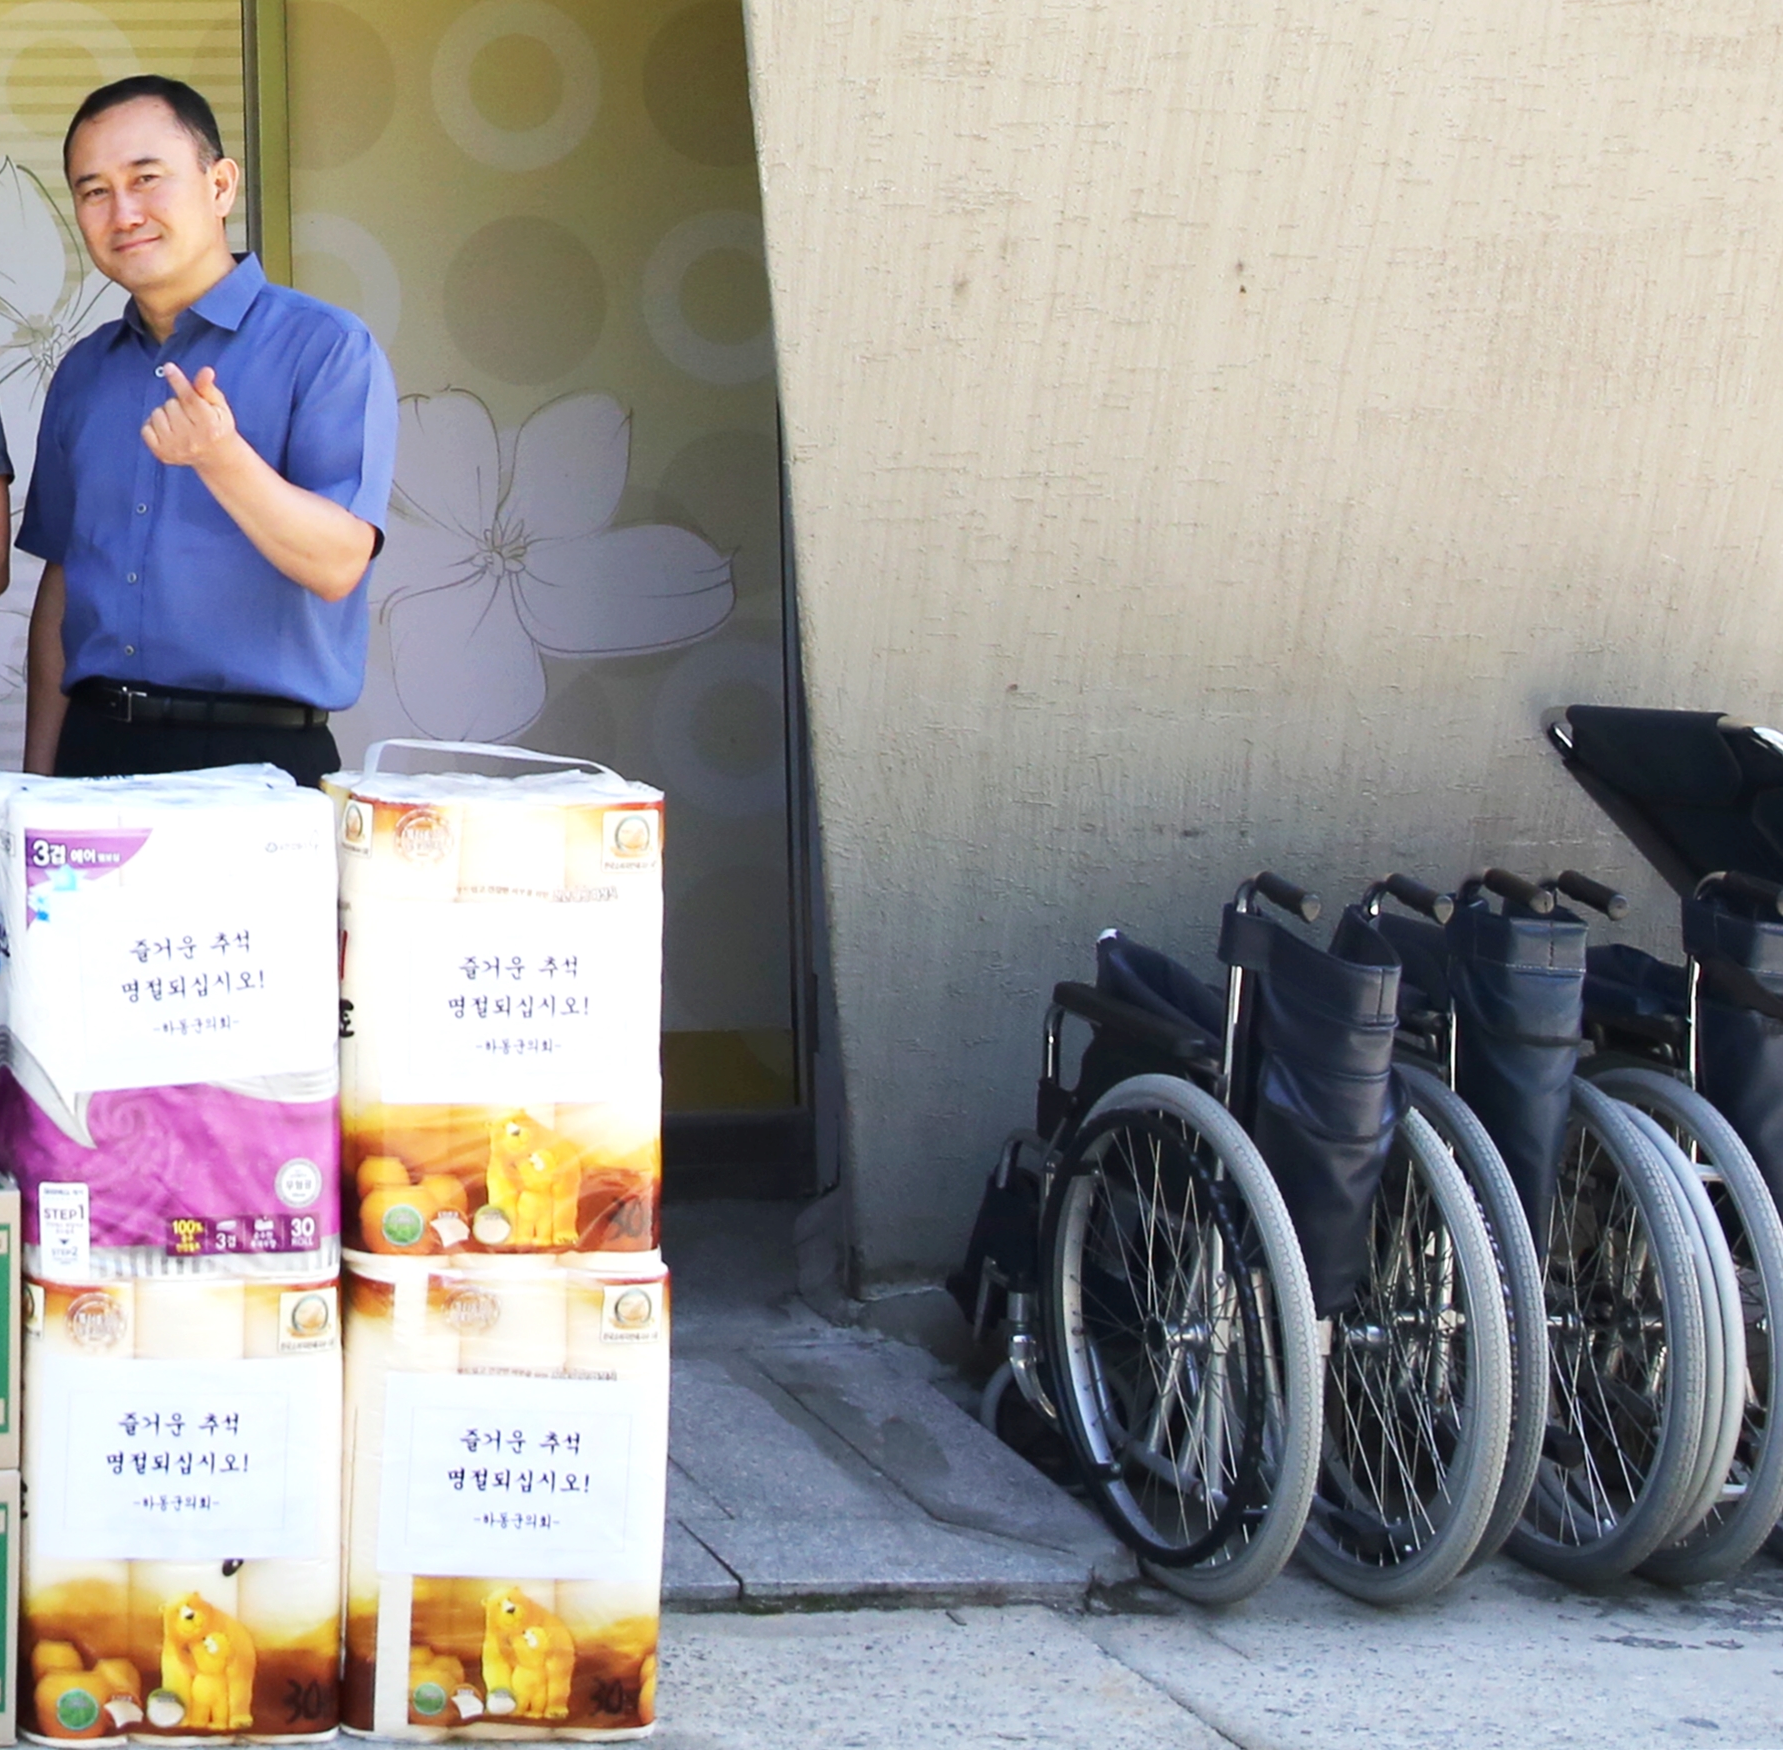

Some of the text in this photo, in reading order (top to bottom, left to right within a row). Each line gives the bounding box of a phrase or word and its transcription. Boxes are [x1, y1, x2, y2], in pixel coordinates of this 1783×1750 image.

[33, 839, 66, 866] 3겹
[70, 848, 96, 864] 에어
[130, 930, 249, 963] 즐거운 추석
[460, 956, 577, 980] 즐거운 추석
[122, 970, 263, 1003] 명절되십시오!
[449, 995, 588, 1019] 명절되십시오!
[291, 1217, 315, 1237] 30
[119, 1413, 238, 1437] 즐거운 추석
[461, 1429, 580, 1454] 즐거운 추석
[107, 1452, 248, 1475] 명절되십시오!
[448, 1468, 589, 1493] 명절되십시오!
